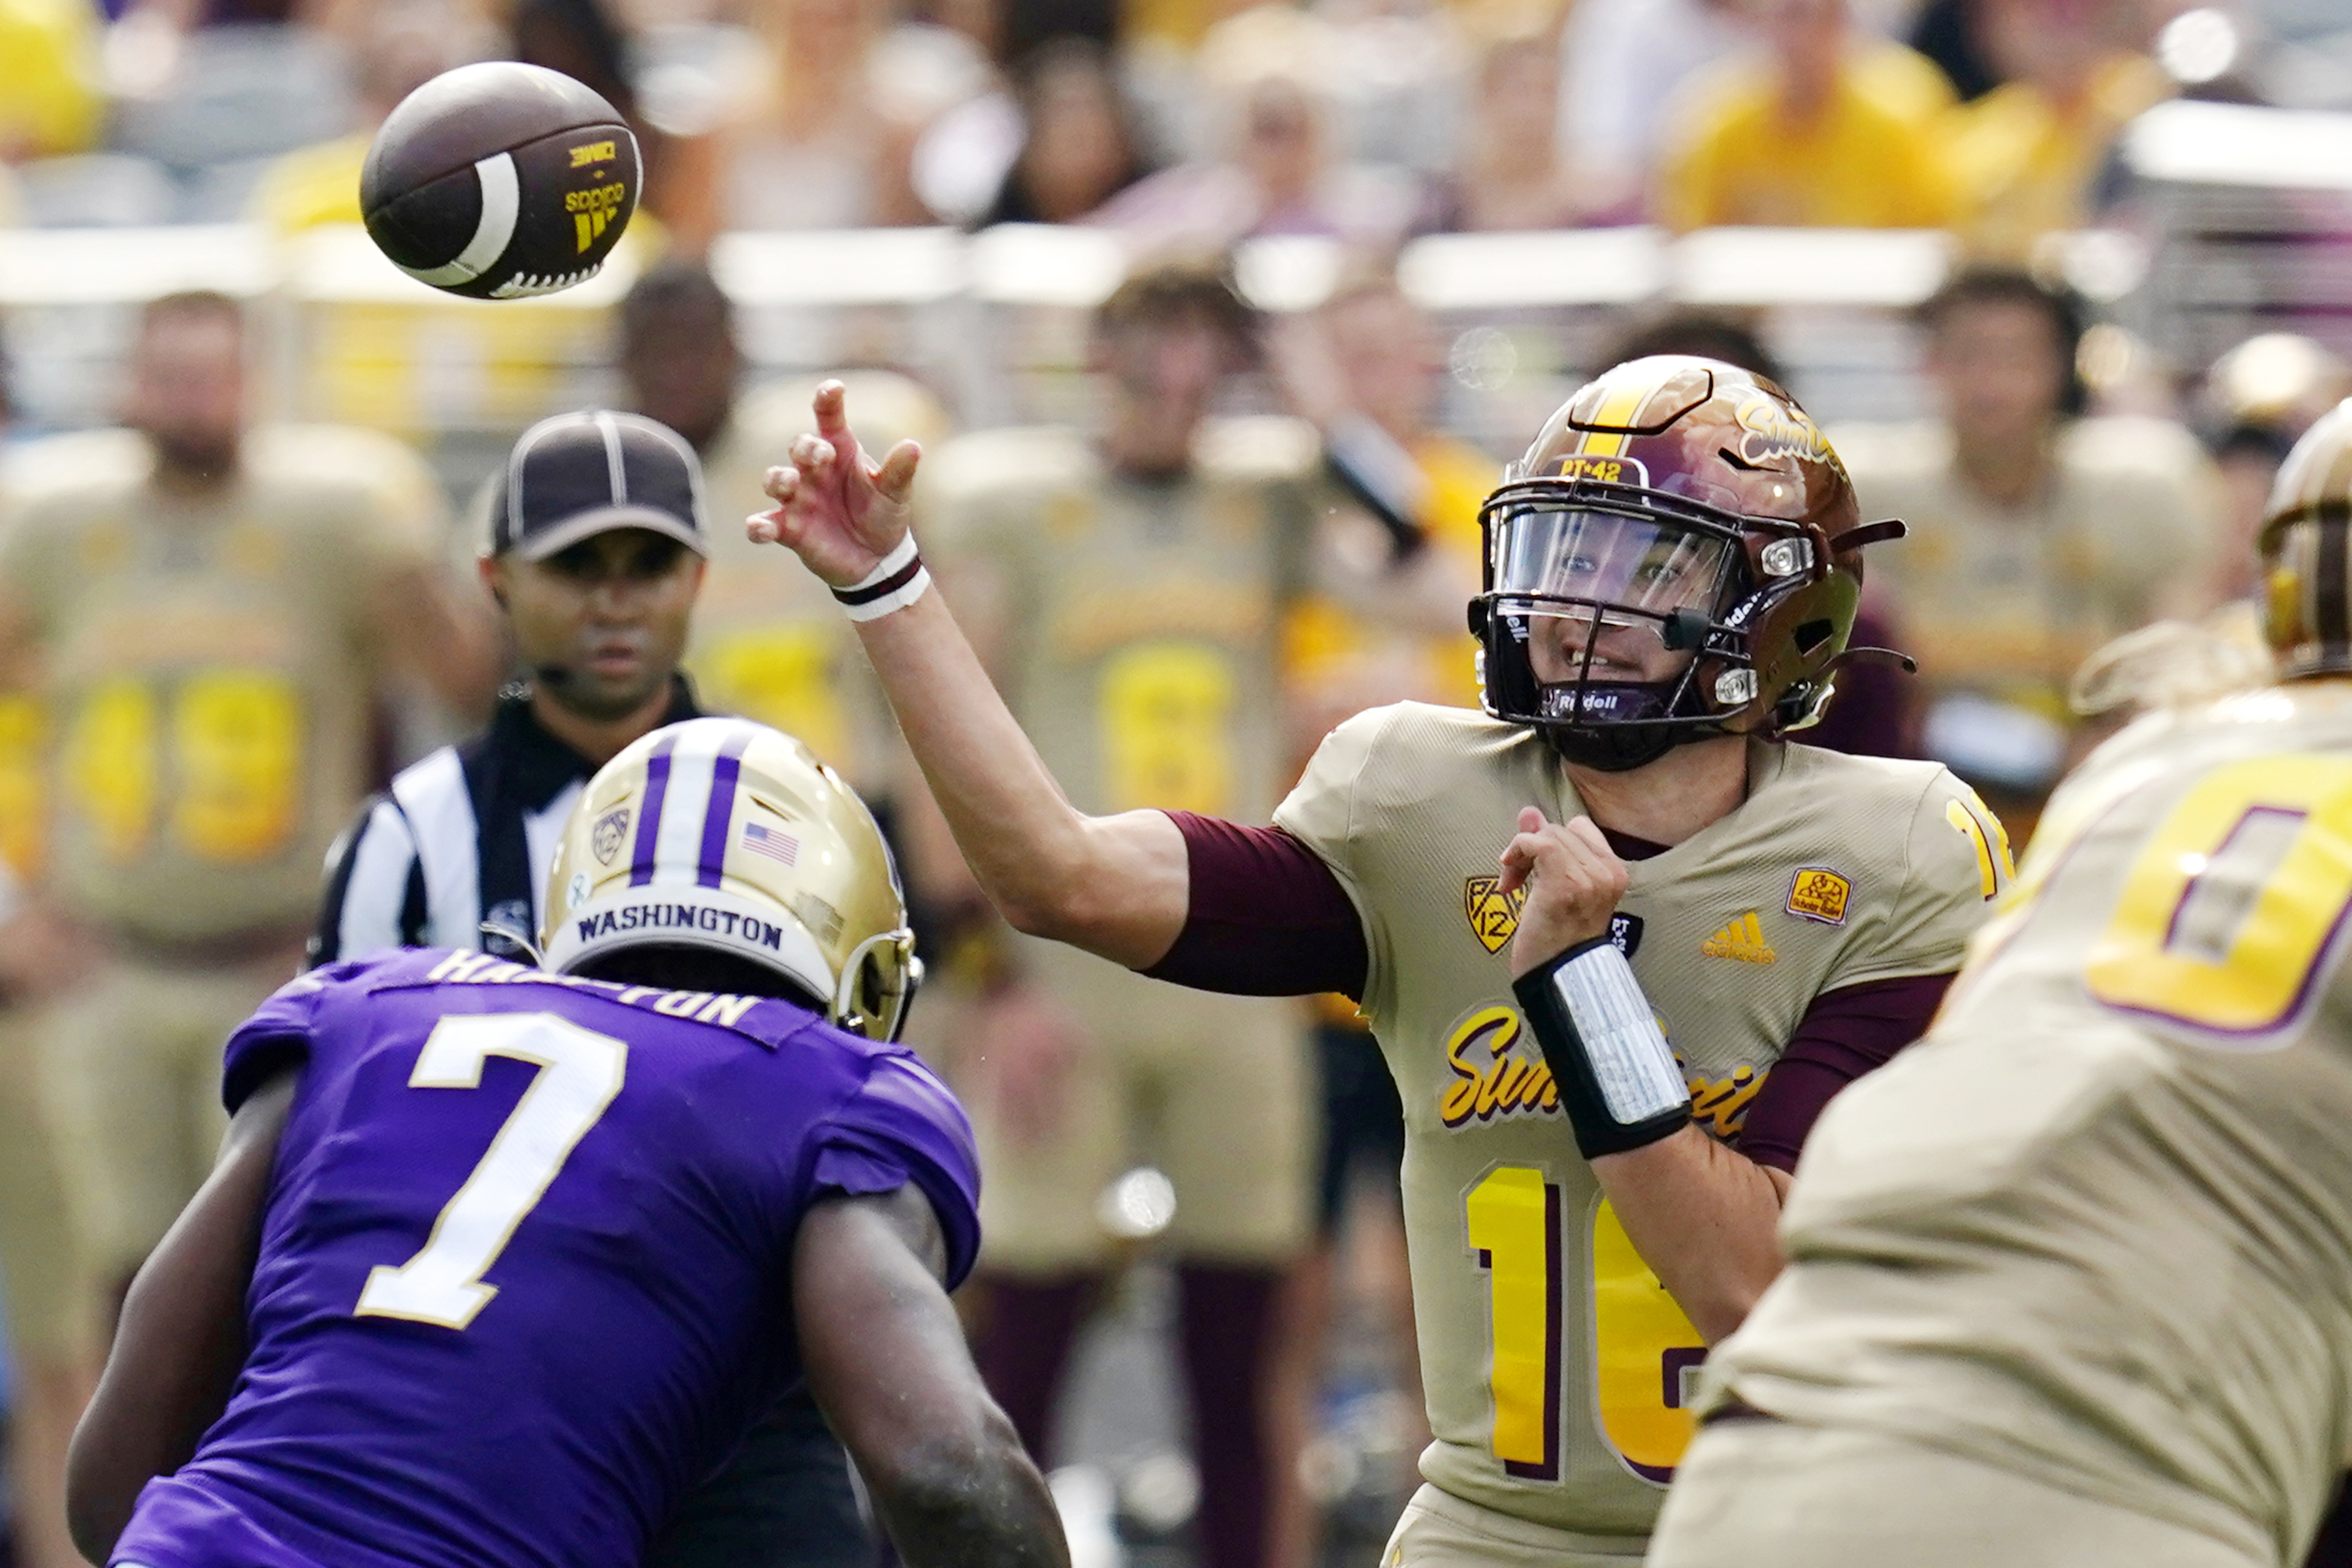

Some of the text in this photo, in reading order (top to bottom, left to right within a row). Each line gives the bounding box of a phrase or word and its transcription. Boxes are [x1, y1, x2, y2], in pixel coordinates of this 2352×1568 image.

[565, 182, 625, 212] adidas
[1559, 694, 1618, 711] Ridell
[578, 904, 784, 951] WASHINGTON
[1479, 910, 1509, 937] 12
[1611, 918, 1630, 933] PT
[1701, 941, 1775, 964] adidas
[1441, 1005, 1560, 1129] Sun
[353, 1012, 629, 1331] 7
